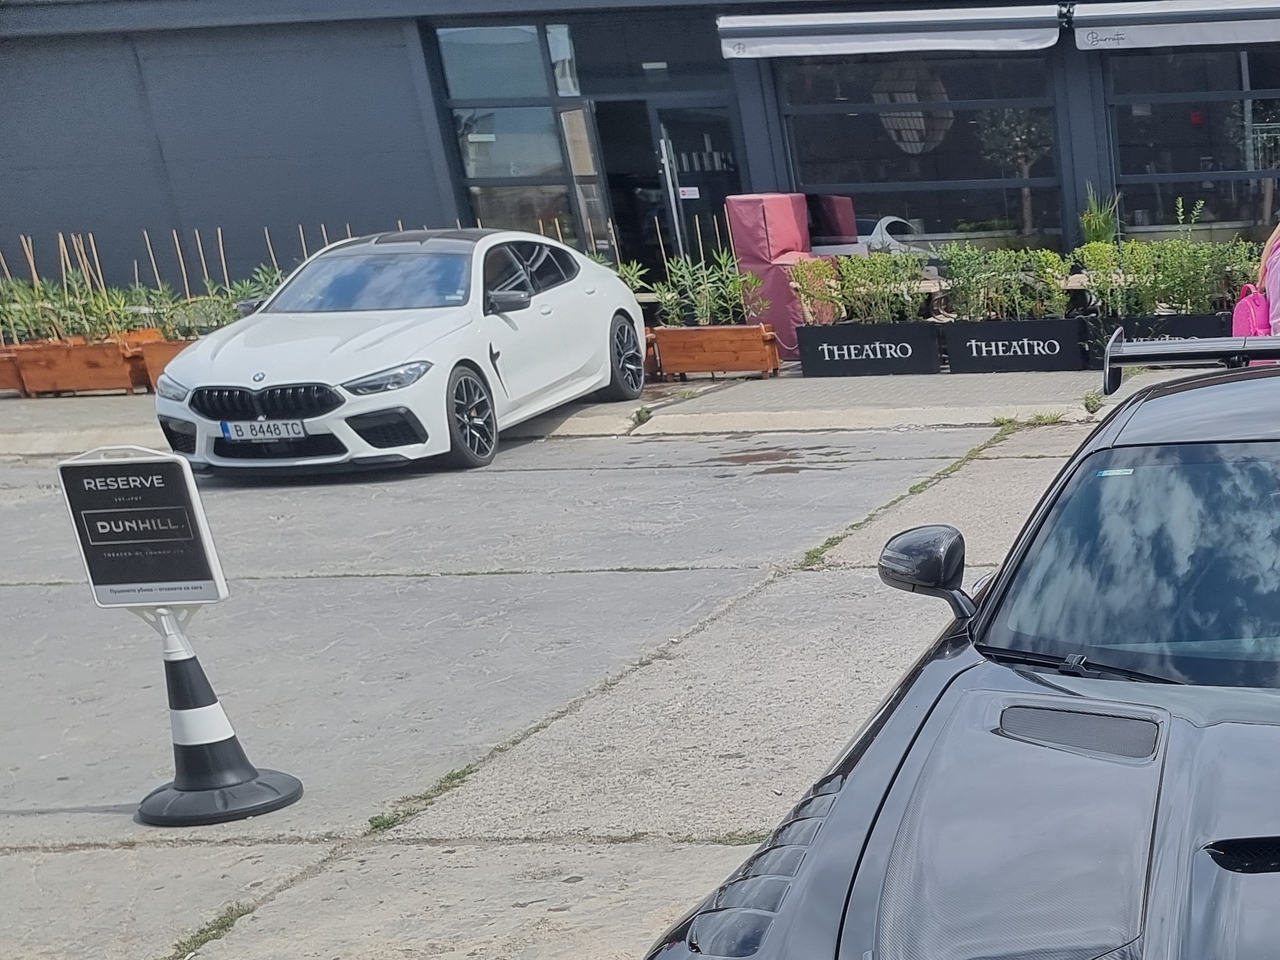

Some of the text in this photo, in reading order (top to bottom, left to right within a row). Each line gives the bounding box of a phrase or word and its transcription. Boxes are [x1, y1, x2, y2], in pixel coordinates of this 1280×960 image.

[818, 341, 913, 361] THEATRO
[966, 338, 1061, 358] THEATRO
[234, 422, 301, 437] B 8448 TC
[82, 475, 165, 491] RESERVE
